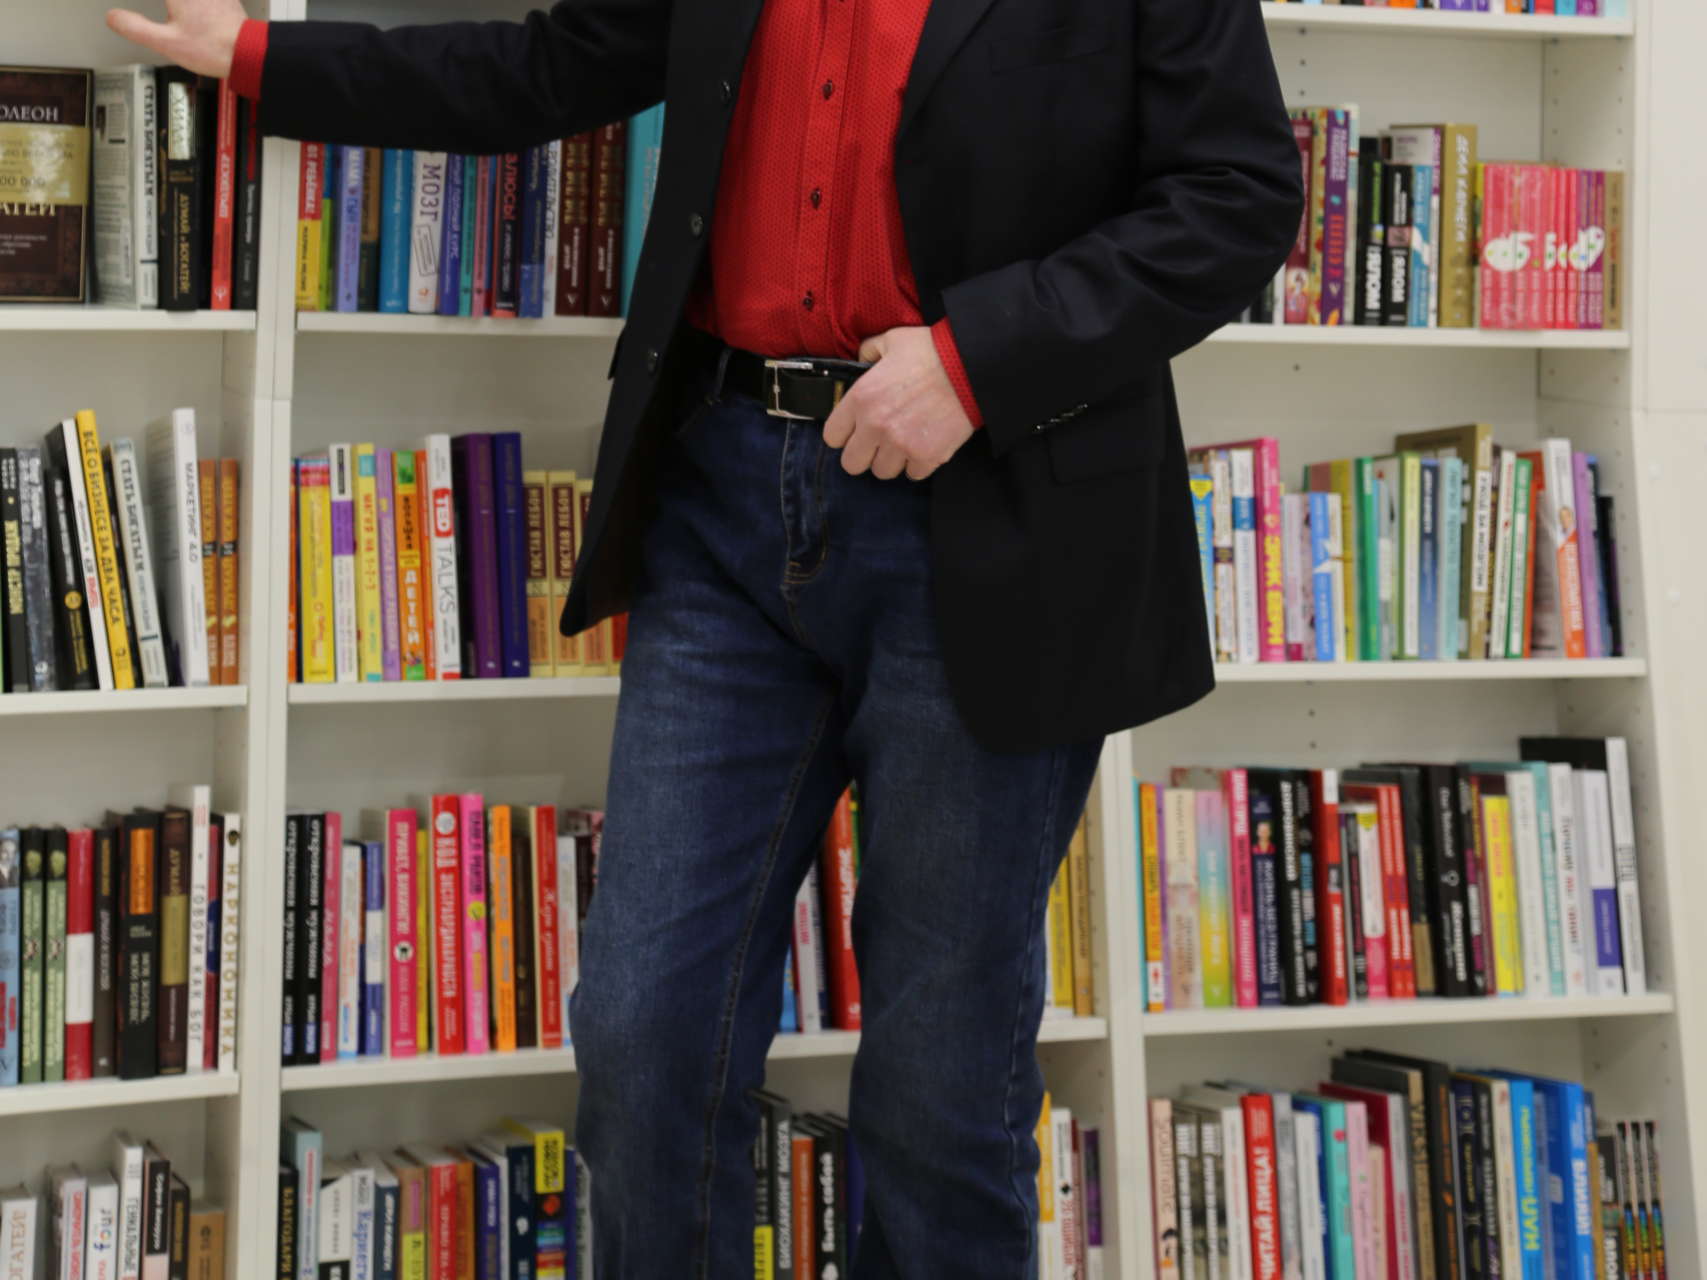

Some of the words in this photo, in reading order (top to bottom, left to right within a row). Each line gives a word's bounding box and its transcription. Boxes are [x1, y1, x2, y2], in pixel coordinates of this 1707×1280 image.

[418, 164, 441, 222] МОЗГ
[1365, 251, 1382, 309] ЯЛОМ
[1390, 256, 1407, 303] ЯЛОМ
[436, 544, 455, 614] TALKS
